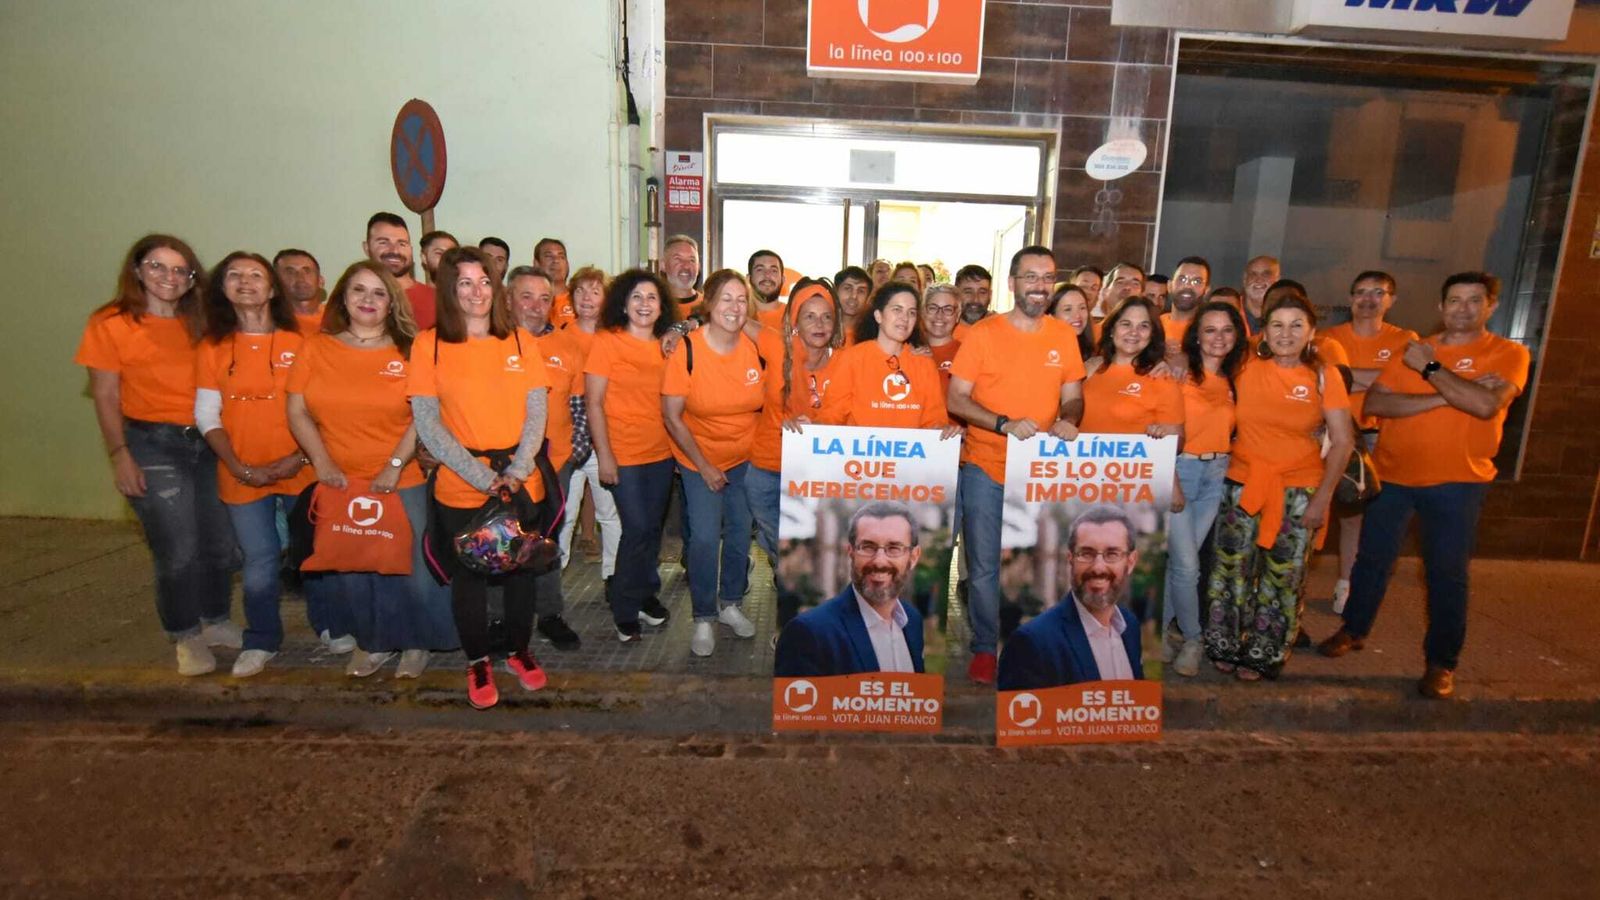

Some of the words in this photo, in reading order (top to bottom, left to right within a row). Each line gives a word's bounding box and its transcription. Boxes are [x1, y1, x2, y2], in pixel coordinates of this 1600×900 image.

[829, 43, 844, 59] la
[669, 176, 700, 187] Alarma
[812, 437, 844, 455] LA
[852, 435, 926, 458] LÍNEA
[1038, 440, 1070, 457] LA
[1077, 436, 1147, 458] LÍNEA
[844, 460, 896, 480] QUE
[1029, 461, 1059, 478] ES
[1066, 462, 1097, 479] LO
[1104, 462, 1153, 483] QUE
[788, 480, 946, 503] MERECEMOS
[1025, 482, 1155, 503] IMPORTA
[332, 524, 341, 532] la
[860, 681, 885, 695] ES
[890, 682, 914, 696] EL
[832, 696, 939, 713] MOMENTO
[1082, 691, 1106, 705] ES
[1112, 690, 1135, 705] EL
[832, 713, 860, 724] VOTA
[863, 714, 891, 724] JUAN
[894, 715, 937, 726] FRANCO
[1056, 705, 1160, 723] MOMENTO
[1056, 725, 1084, 736] VOTA
[1086, 724, 1115, 735] JUAN
[1117, 723, 1159, 734] FRANCO
